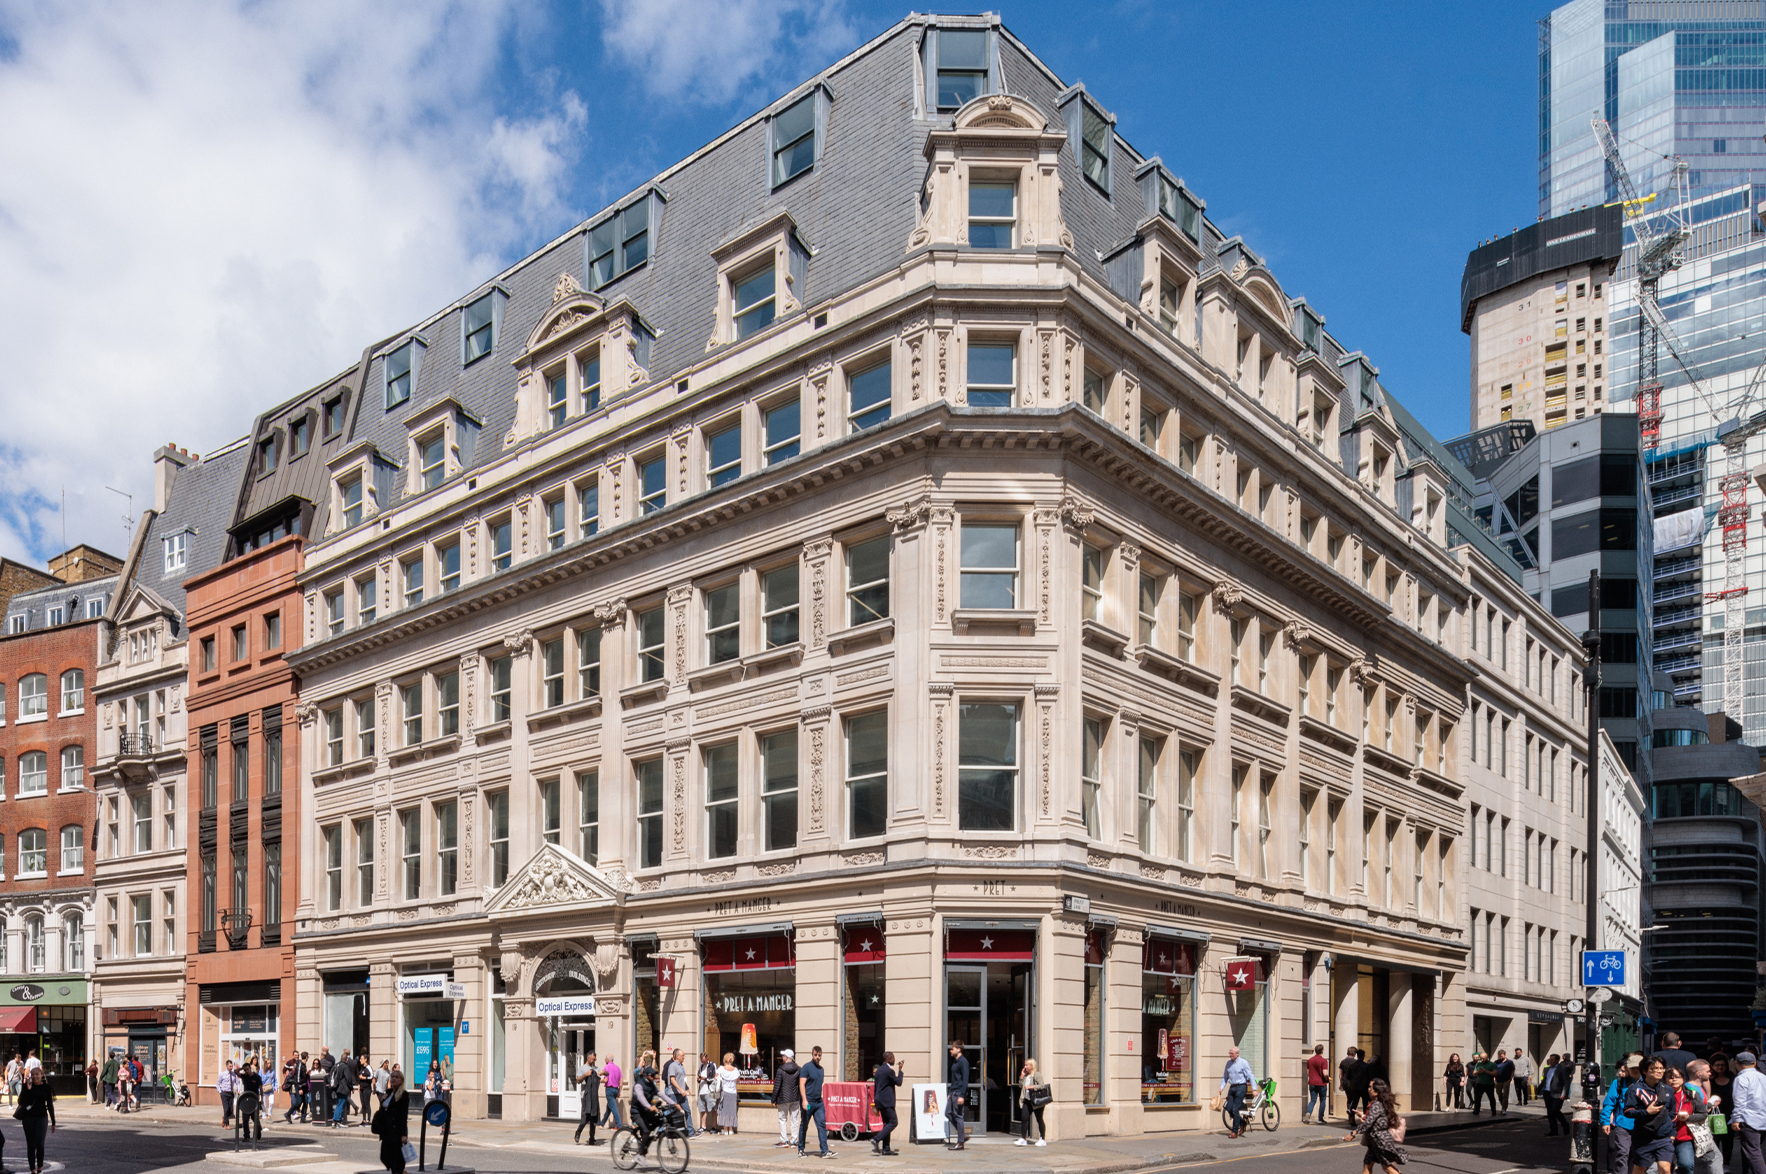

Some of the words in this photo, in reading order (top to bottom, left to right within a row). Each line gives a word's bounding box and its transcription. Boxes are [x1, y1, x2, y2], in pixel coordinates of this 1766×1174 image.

[1518, 301, 1531, 311] 31
[1518, 335, 1532, 345] 30
[1518, 358, 1532, 368] 29
[1518, 381, 1532, 391] 28
[1518, 402, 1532, 412] 27
[983, 880, 1006, 895] PRET
[714, 901, 732, 916] PRET
[734, 902, 739, 914] A
[741, 897, 772, 914] MANGER
[1160, 900, 1172, 914] PRET
[400, 980, 419, 991] Optical
[420, 979, 443, 989] Express
[538, 1002, 563, 1013] Optical
[564, 1001, 593, 1012] Express
[724, 995, 744, 1012] PRET
[747, 996, 753, 1012] A
[756, 994, 793, 1011] MANGER
[1147, 998, 1170, 1015] MANGER
[607, 1021, 613, 1029] 19
[416, 1046, 430, 1054] £595
